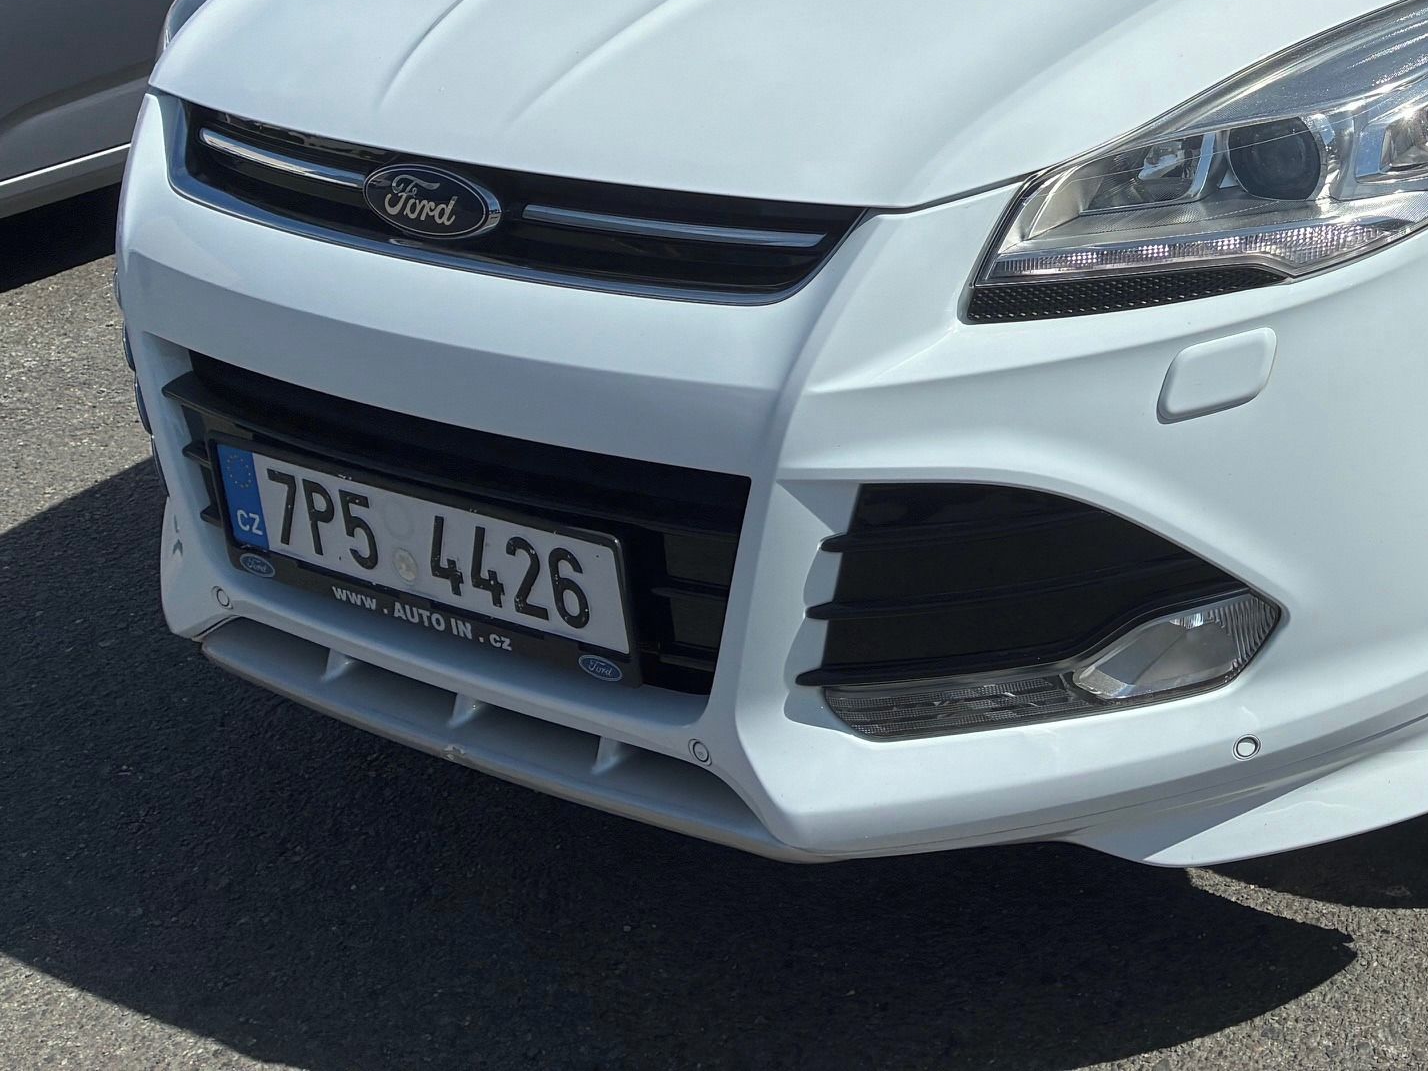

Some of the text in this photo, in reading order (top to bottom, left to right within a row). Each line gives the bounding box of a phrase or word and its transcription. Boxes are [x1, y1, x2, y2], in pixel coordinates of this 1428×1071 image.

[384, 173, 459, 226] Ford
[236, 509, 264, 536] CZ
[266, 468, 590, 629] 7P5 4426
[393, 601, 446, 632] AUTO
[450, 617, 473, 640] IN
